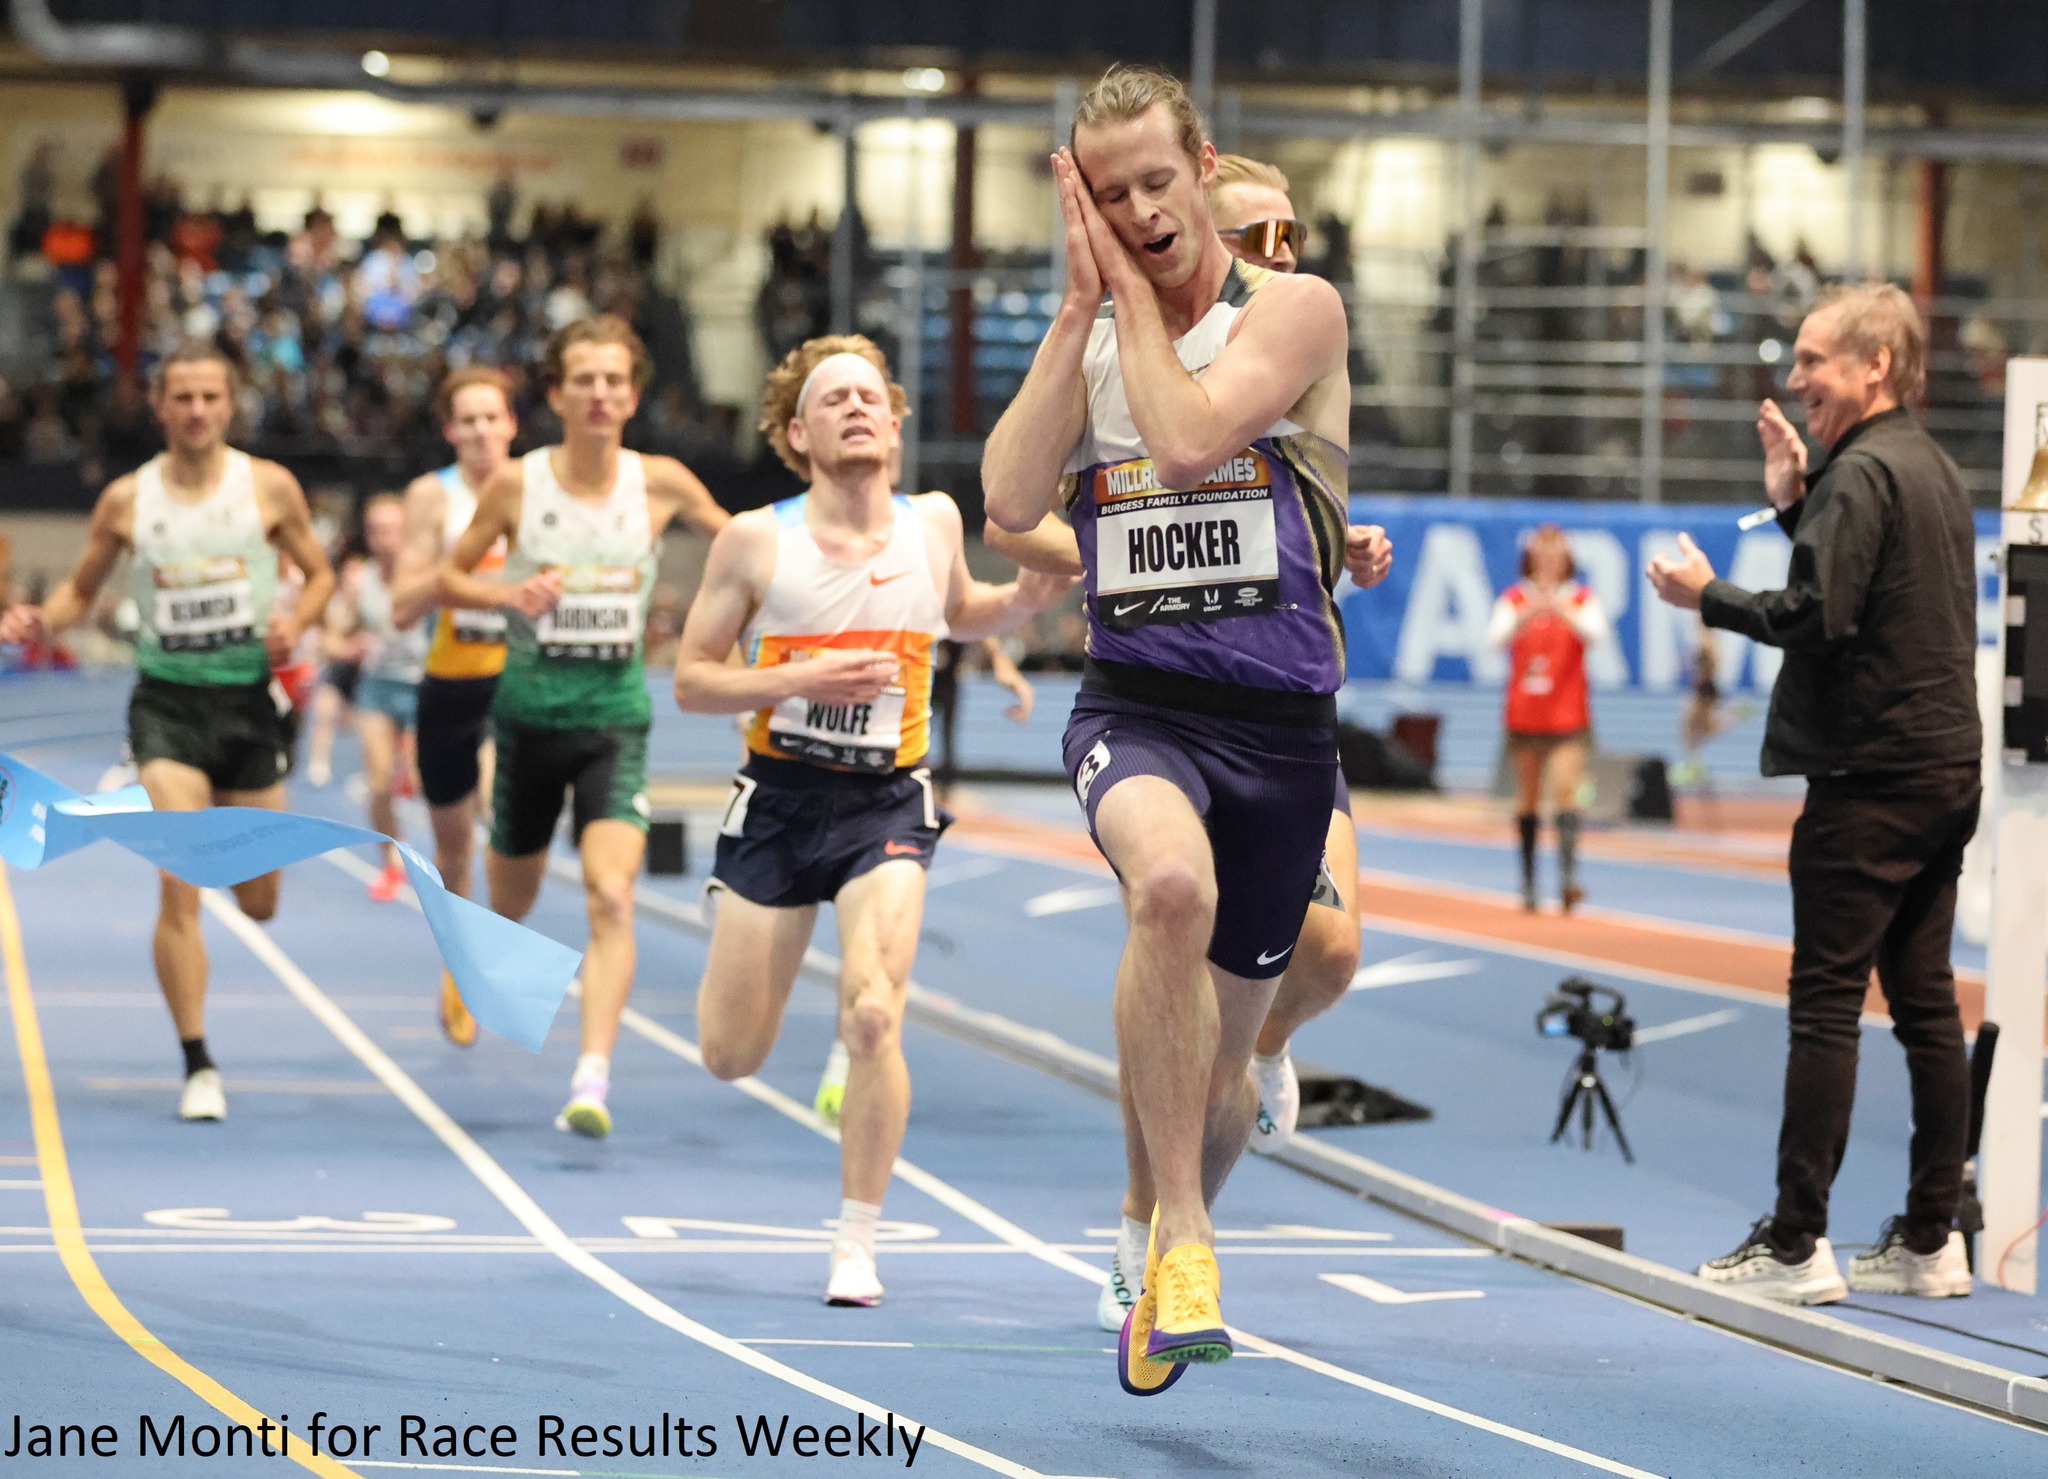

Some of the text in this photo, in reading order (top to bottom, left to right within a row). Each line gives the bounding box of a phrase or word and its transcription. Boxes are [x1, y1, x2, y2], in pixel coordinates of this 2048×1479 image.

[1204, 457, 1257, 484] AMES
[1101, 488, 1268, 516] BURGESS FAMILY FOUNDATION
[1128, 519, 1241, 574] HOCKER
[1160, 603, 1190, 612] ARMORY
[1393, 525, 1790, 693] ARM
[806, 702, 872, 734] WOLFE
[1079, 754, 1100, 791] 3
